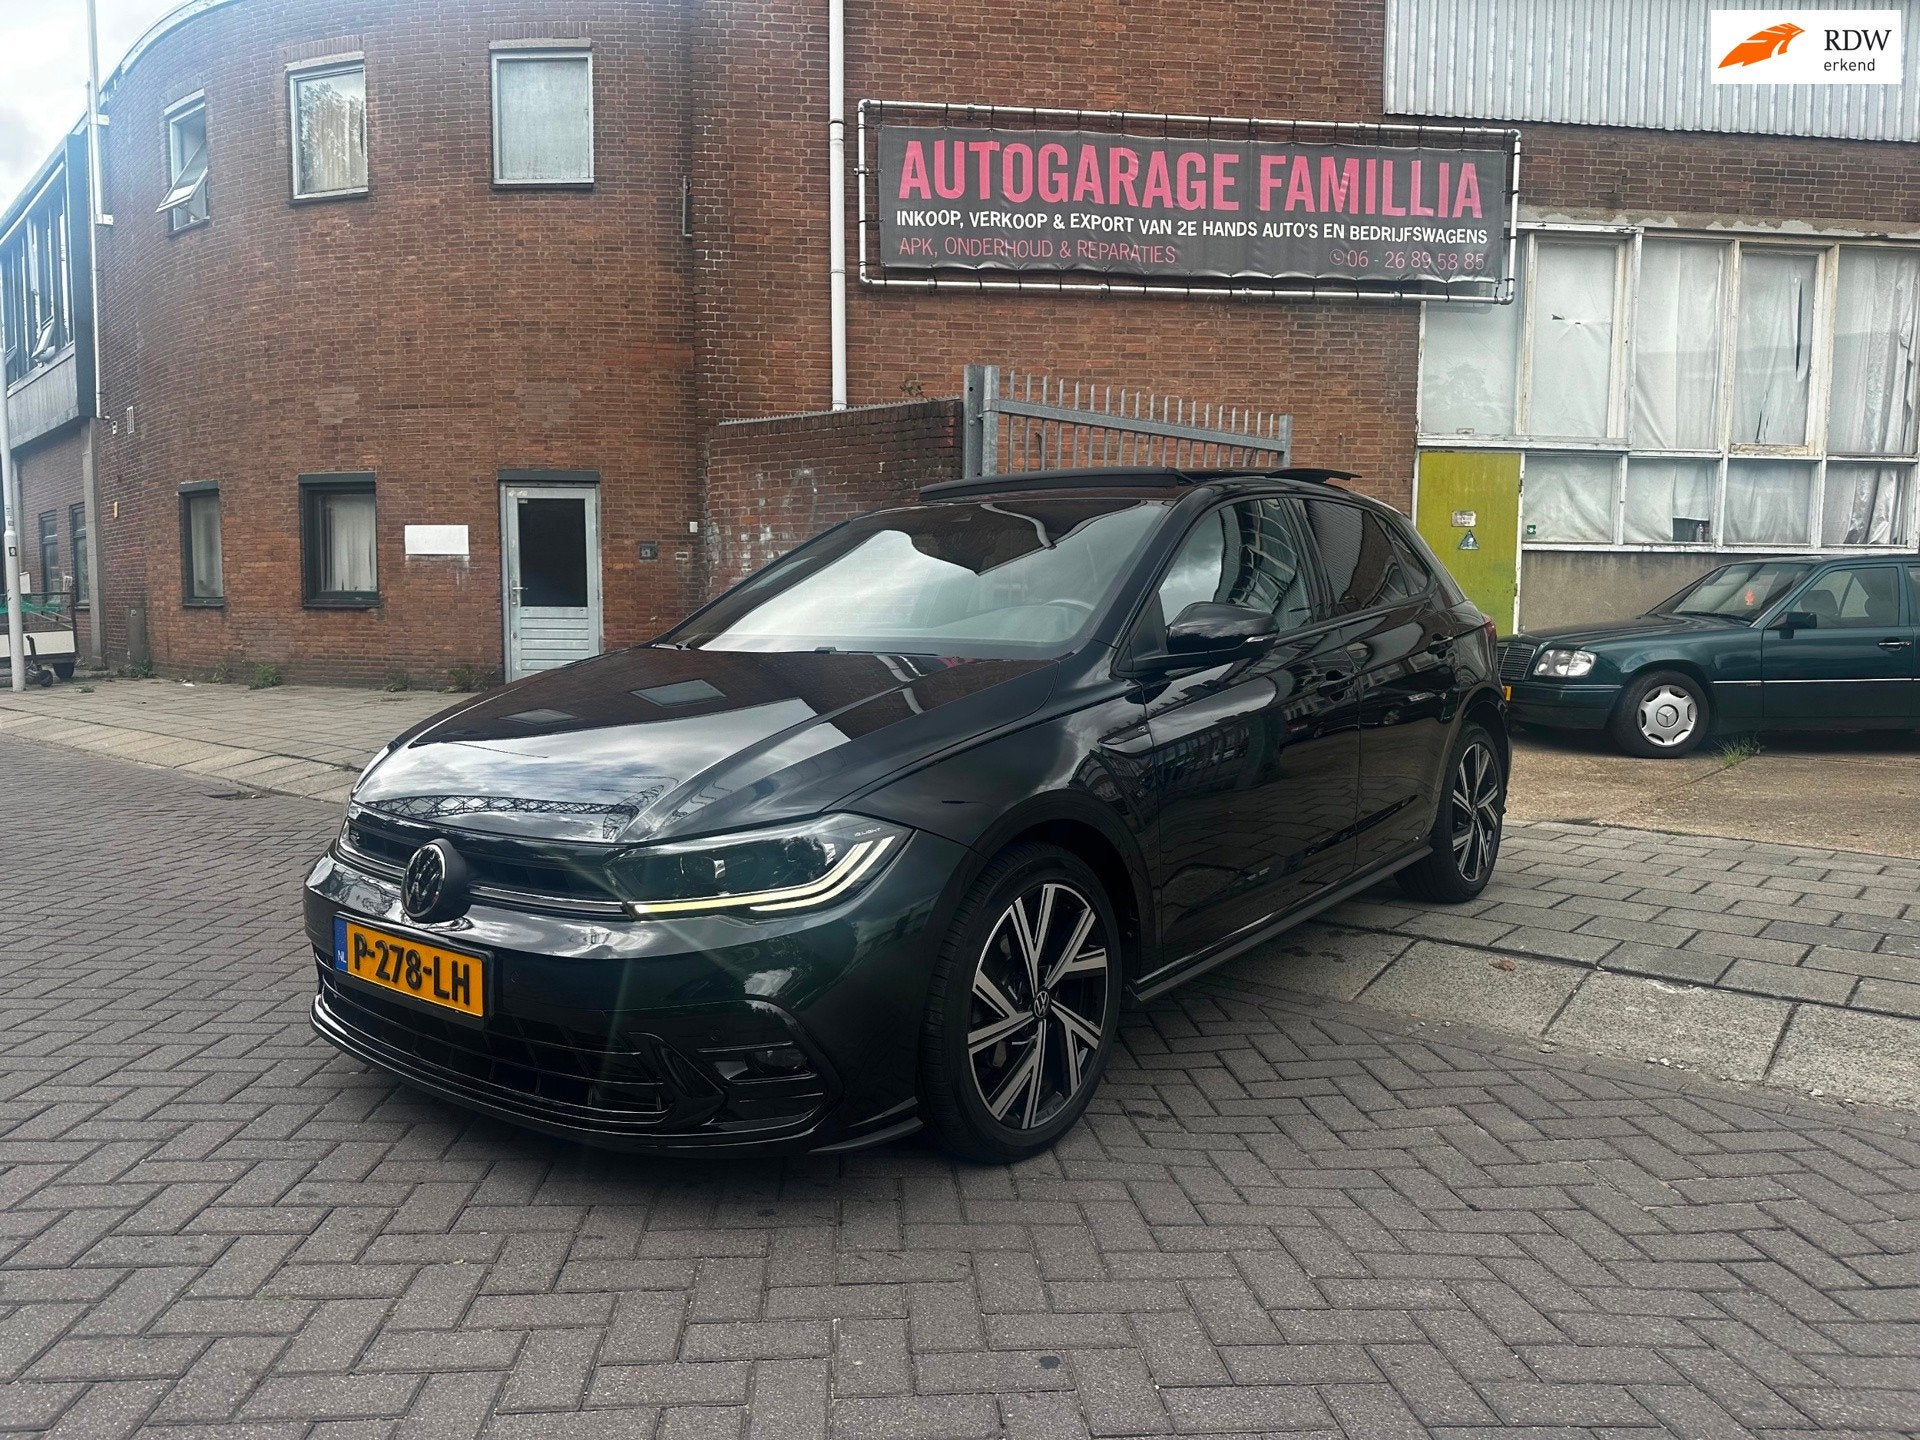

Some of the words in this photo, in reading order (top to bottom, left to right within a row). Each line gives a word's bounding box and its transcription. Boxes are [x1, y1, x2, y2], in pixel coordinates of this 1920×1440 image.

[898, 139, 1240, 211] AUTOGARAGE
[1259, 154, 1483, 219] FAMILLIA
[896, 209, 964, 229] INKOOP,
[968, 211, 1048, 229] VERKOOP
[1053, 213, 1066, 230] &
[1070, 213, 1134, 233] EXPORT
[1139, 218, 1172, 236] VAN
[1177, 220, 1197, 237] 2E
[1202, 220, 1258, 237] HANDS
[1262, 222, 1319, 239] AUTO'S
[1323, 223, 1345, 239] EN
[1349, 225, 1488, 244] BEDRIJFSWAGENS
[899, 237, 938, 257] APK,
[944, 236, 1053, 259] ONDERHOUD
[1060, 240, 1072, 259] &
[1077, 239, 1176, 264] REPARATIES
[1347, 250, 1369, 267] 06
[1384, 251, 1405, 269] 26
[1411, 250, 1432, 268] 89
[1437, 252, 1458, 270] 58
[1464, 252, 1485, 270] 85
[337, 949, 347, 964] NL
[353, 932, 471, 1006] P-278-LH
